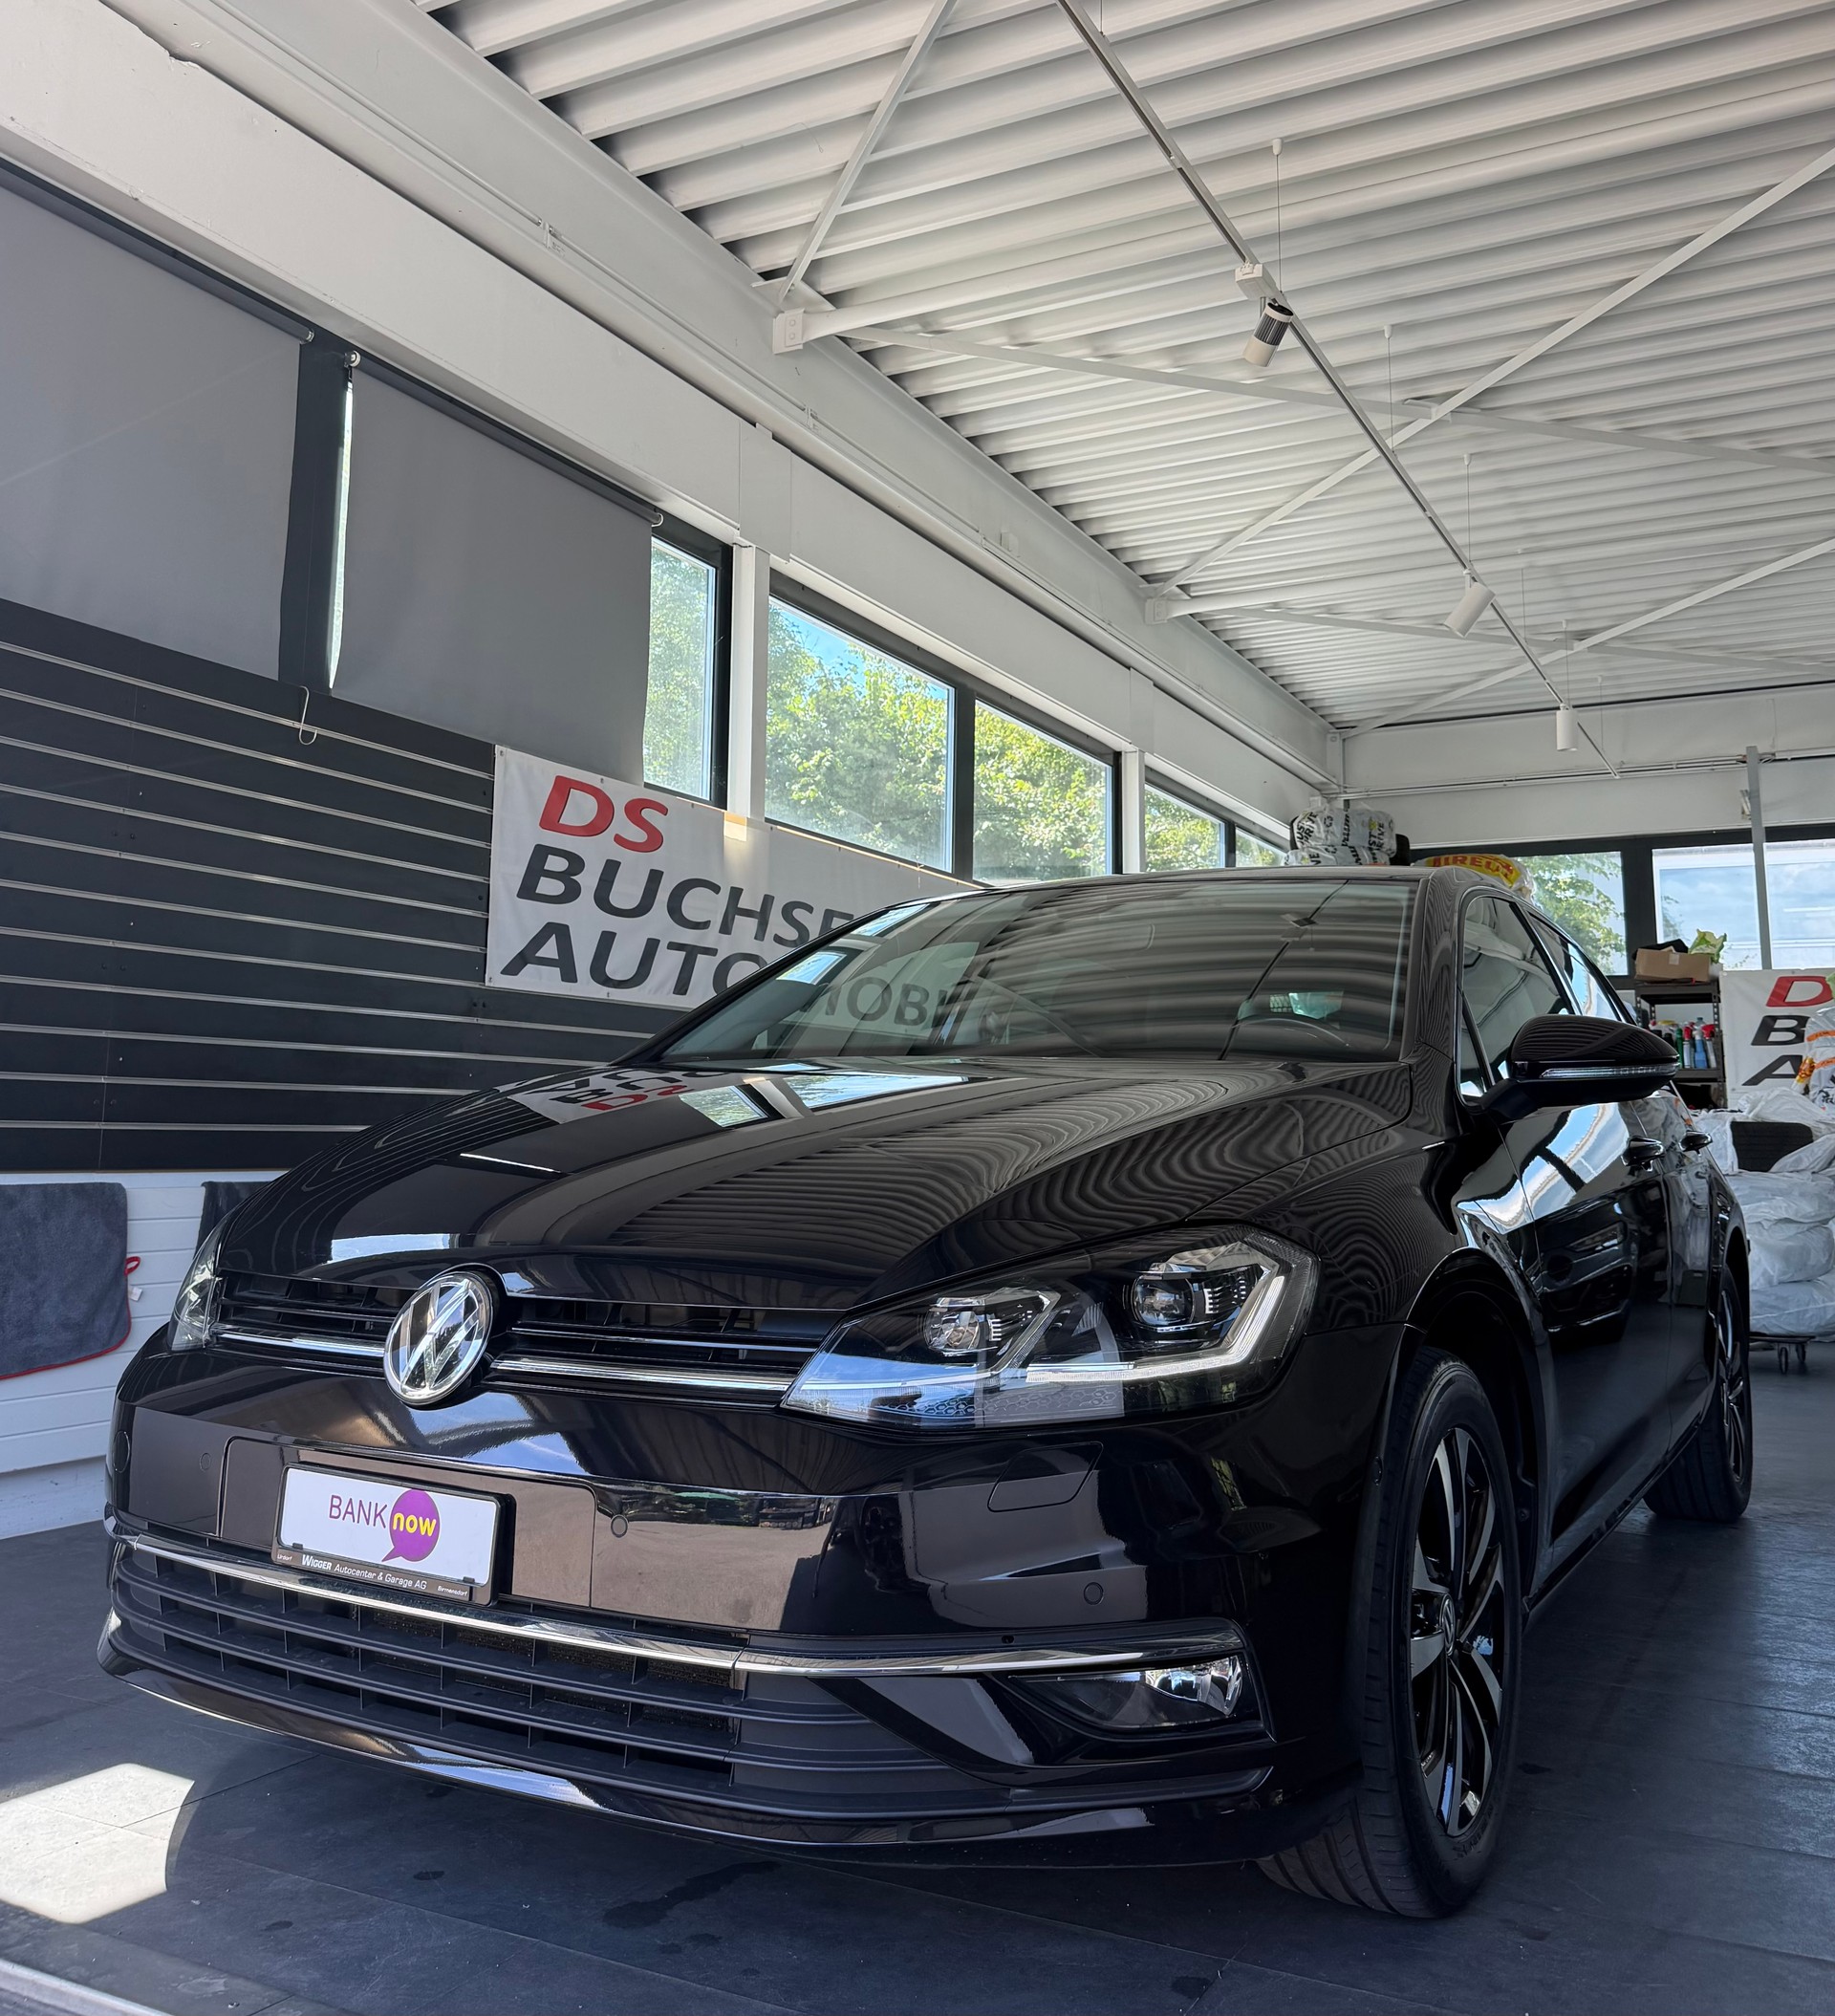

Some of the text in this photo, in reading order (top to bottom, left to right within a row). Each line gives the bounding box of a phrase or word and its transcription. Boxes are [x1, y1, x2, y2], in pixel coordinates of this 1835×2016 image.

[538, 774, 669, 854] DS
[329, 1494, 437, 1537] BANK now
[301, 1554, 333, 1572] WIGGER
[334, 1563, 377, 1579] Autocenter
[377, 1572, 383, 1581] &
[384, 1573, 413, 1588] Garage
[414, 1579, 427, 1591] AG
